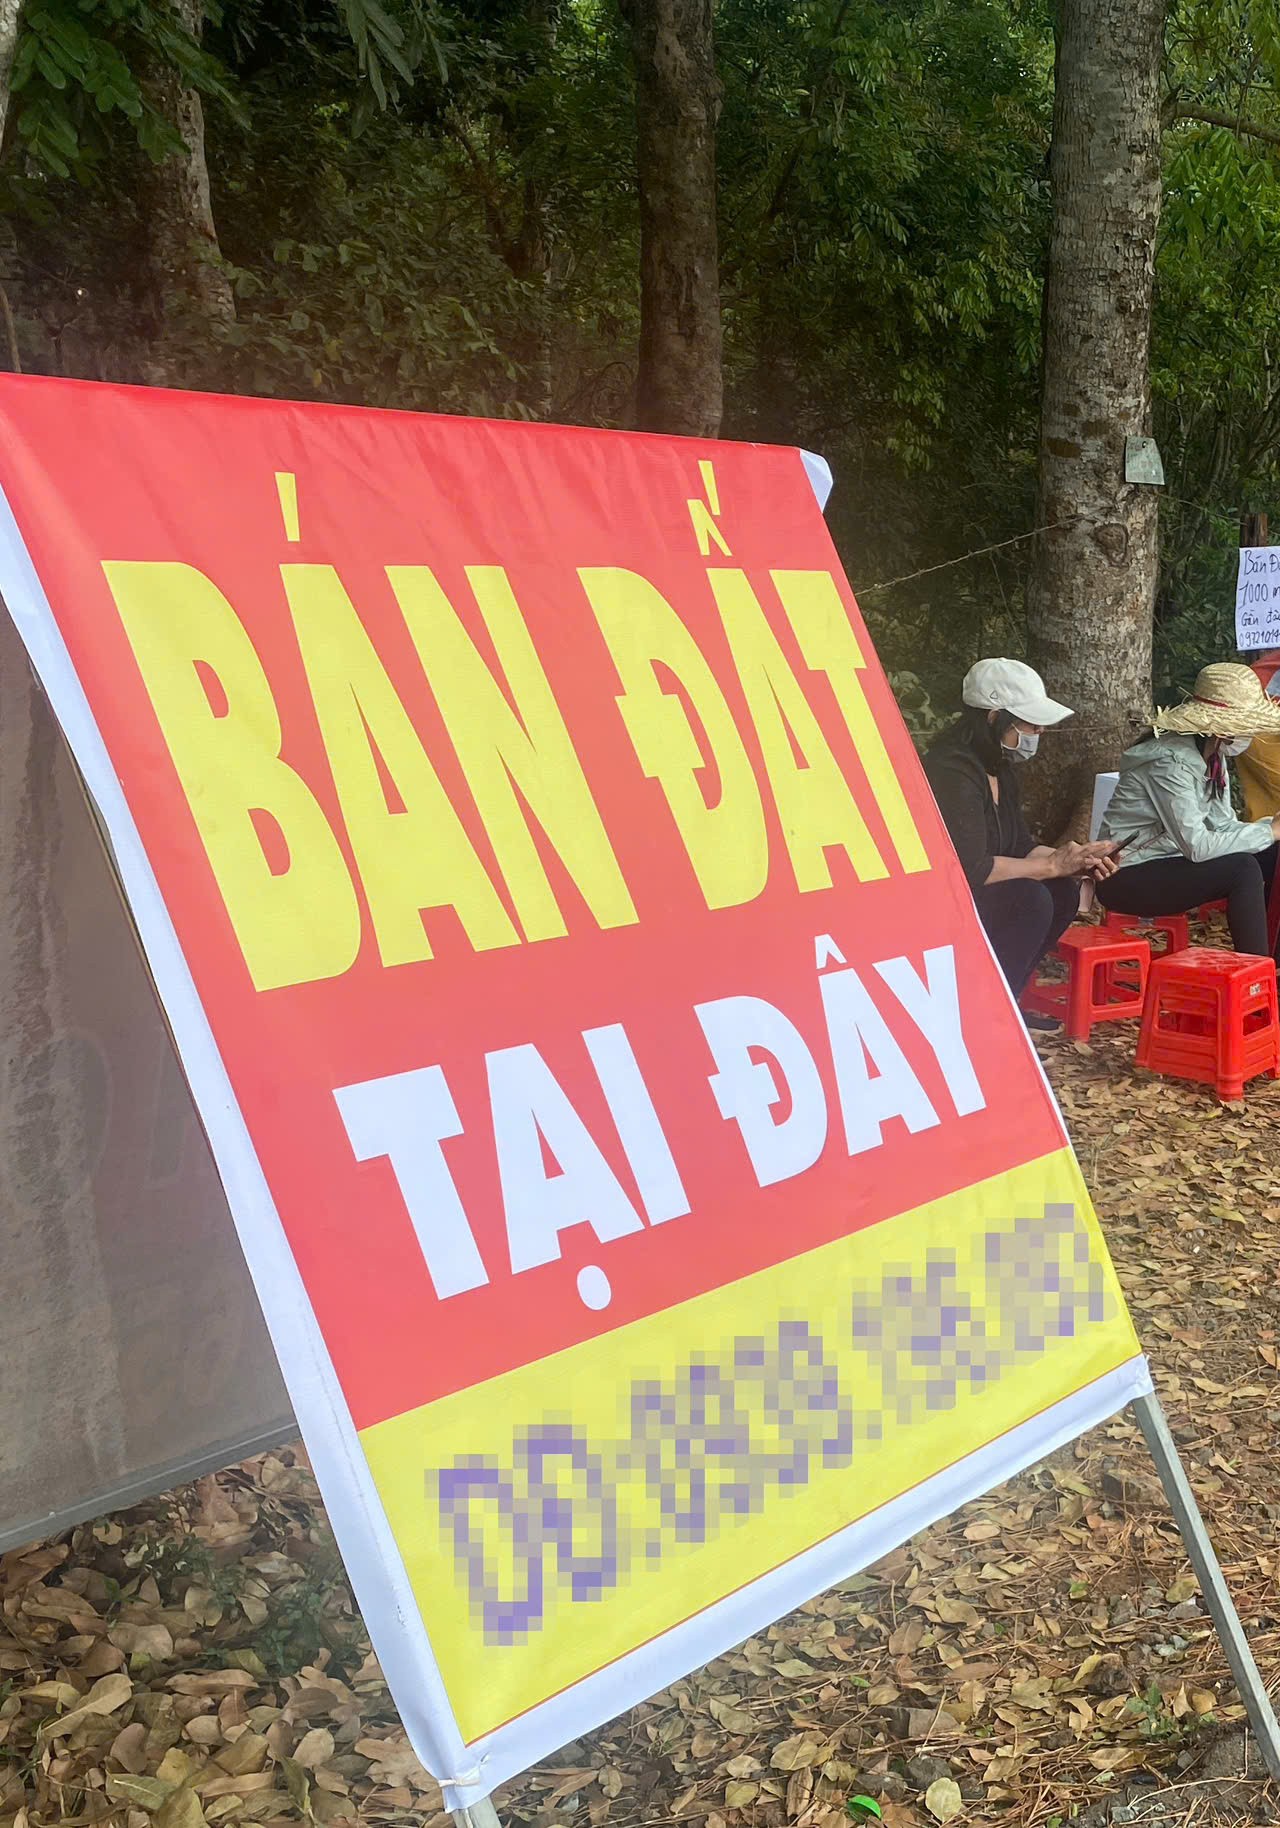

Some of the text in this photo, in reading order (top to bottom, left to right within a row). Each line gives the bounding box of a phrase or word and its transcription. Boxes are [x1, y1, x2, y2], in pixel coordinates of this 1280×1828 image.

[100, 460, 932, 992] BÁN ĐẤT
[332, 934, 987, 1311] TẠI ĐÂY
